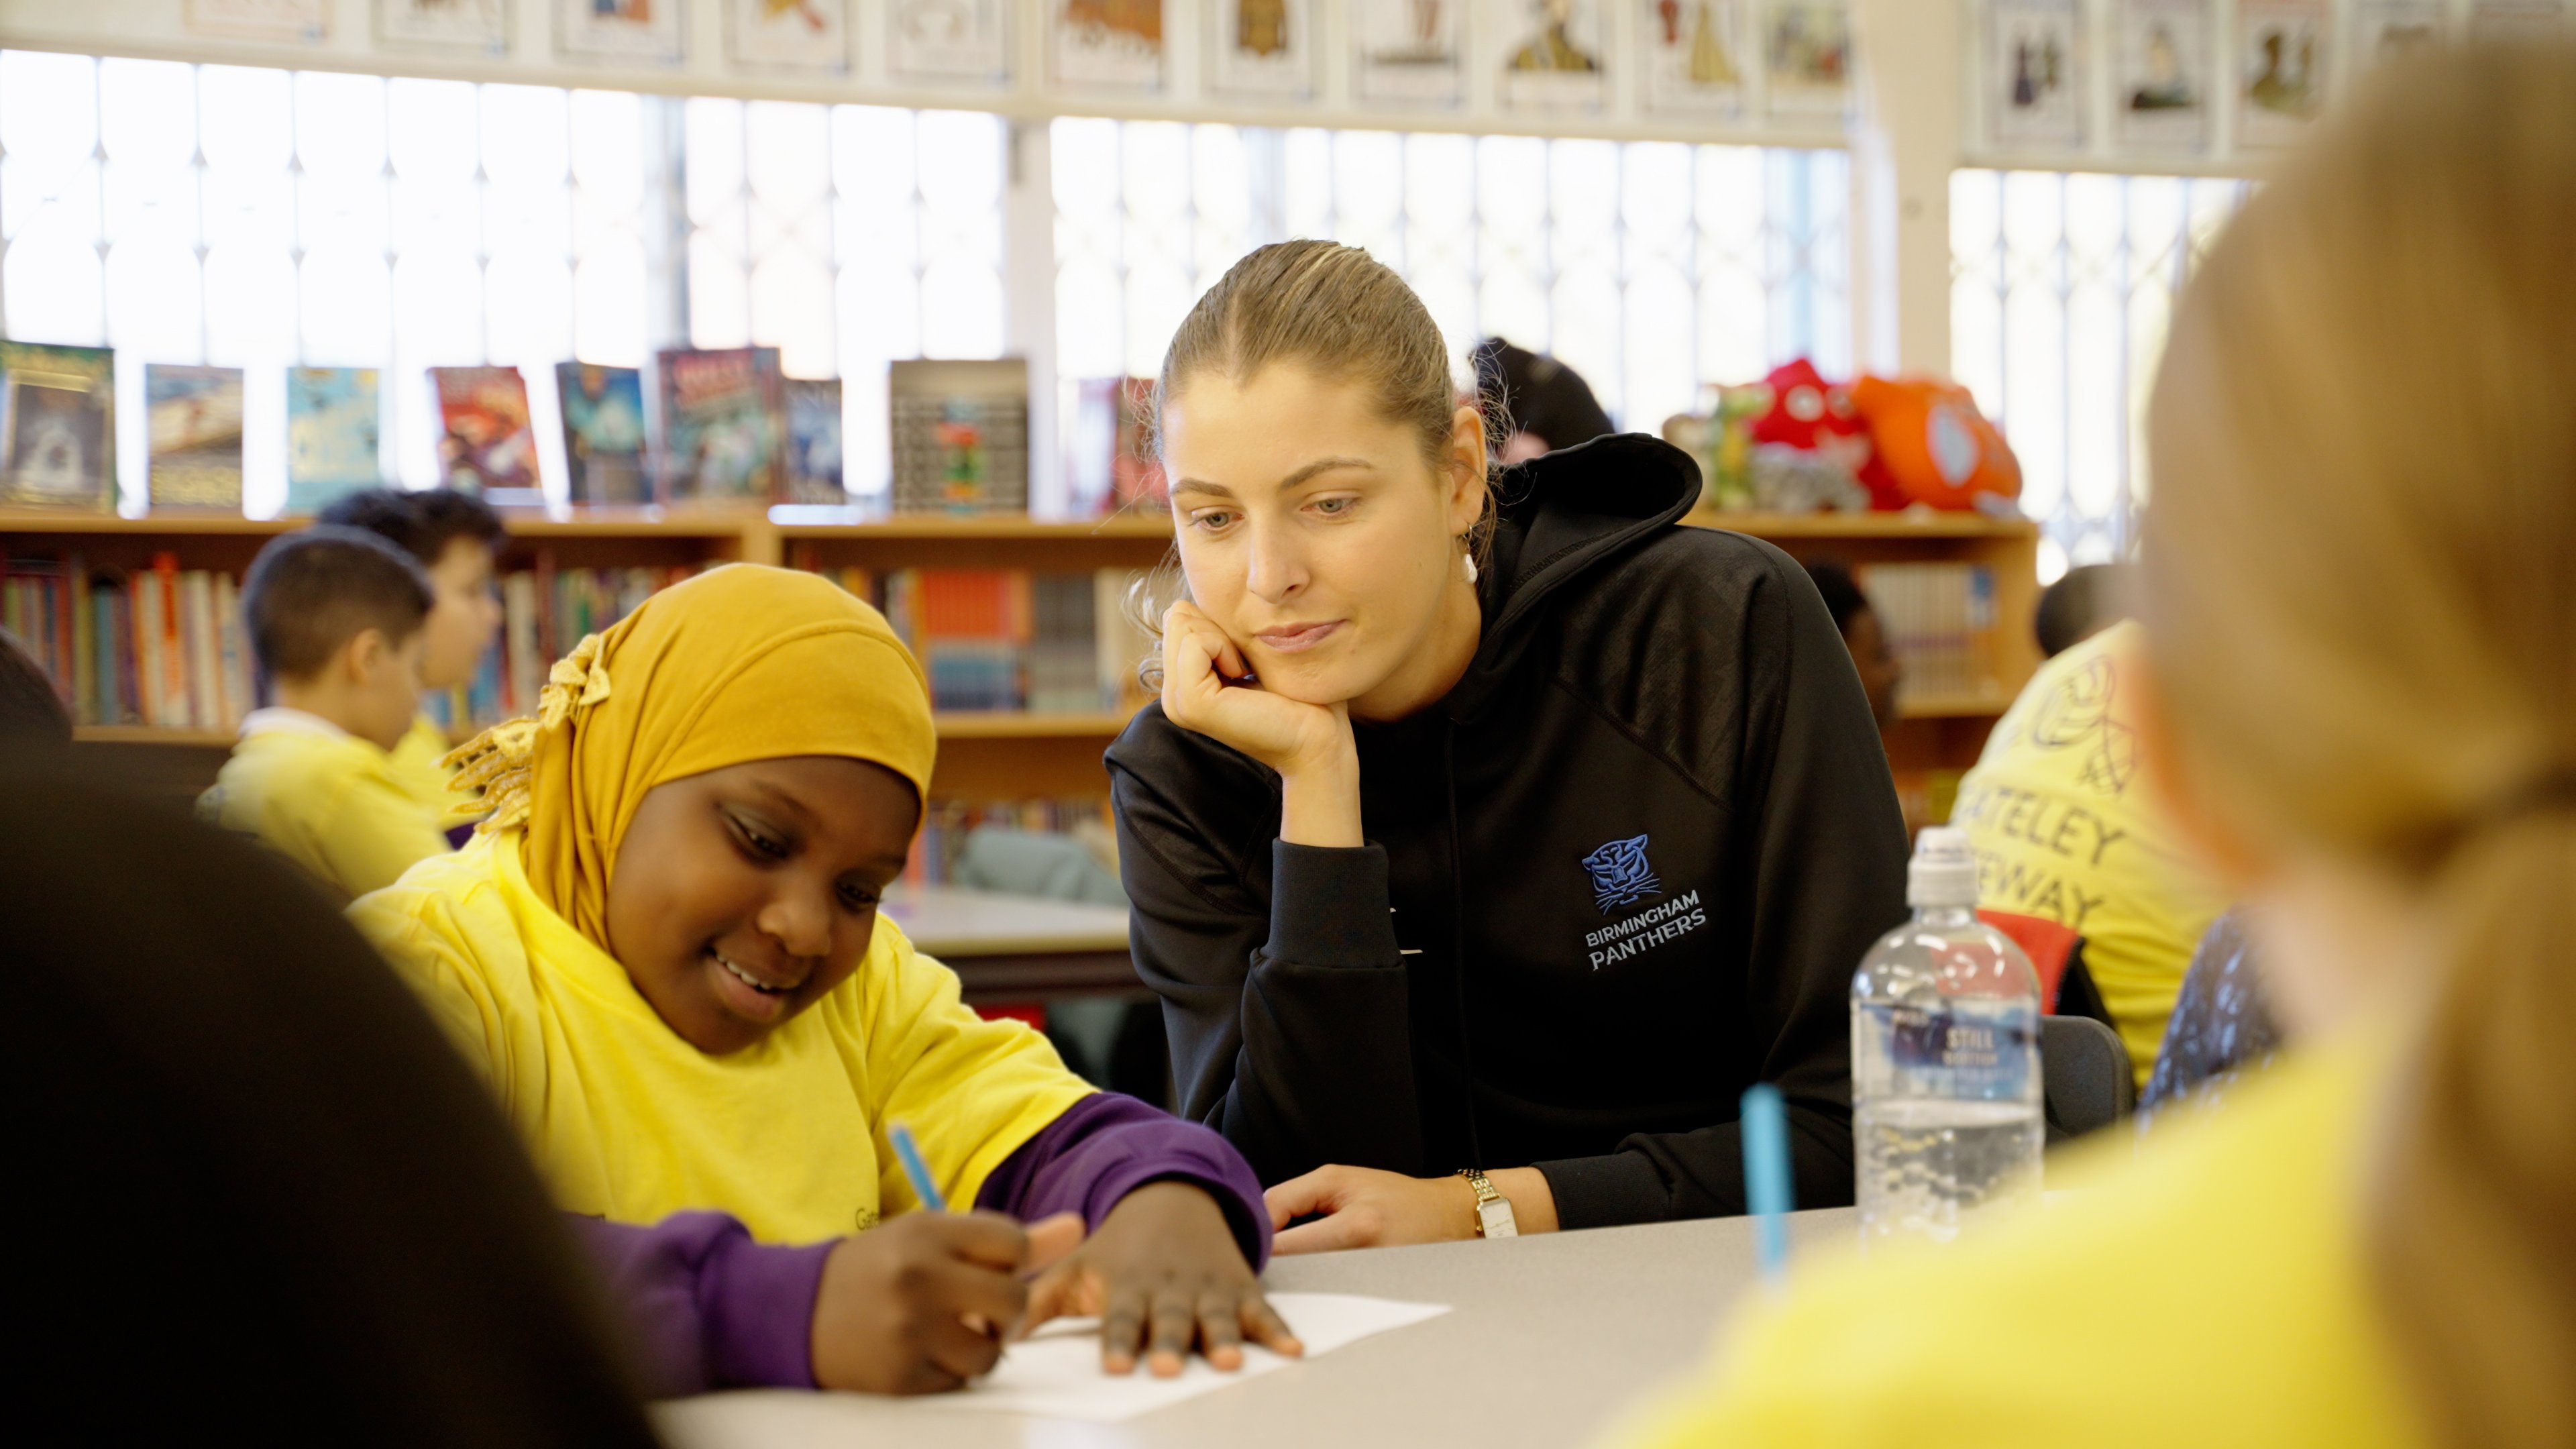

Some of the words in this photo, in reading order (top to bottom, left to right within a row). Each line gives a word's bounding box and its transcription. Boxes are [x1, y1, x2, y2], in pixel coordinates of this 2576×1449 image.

[1585, 890, 1700, 947] BIRMINGHAM
[1589, 908, 1707, 971] PANTHERS
[1947, 1026, 1994, 1050] STILL
